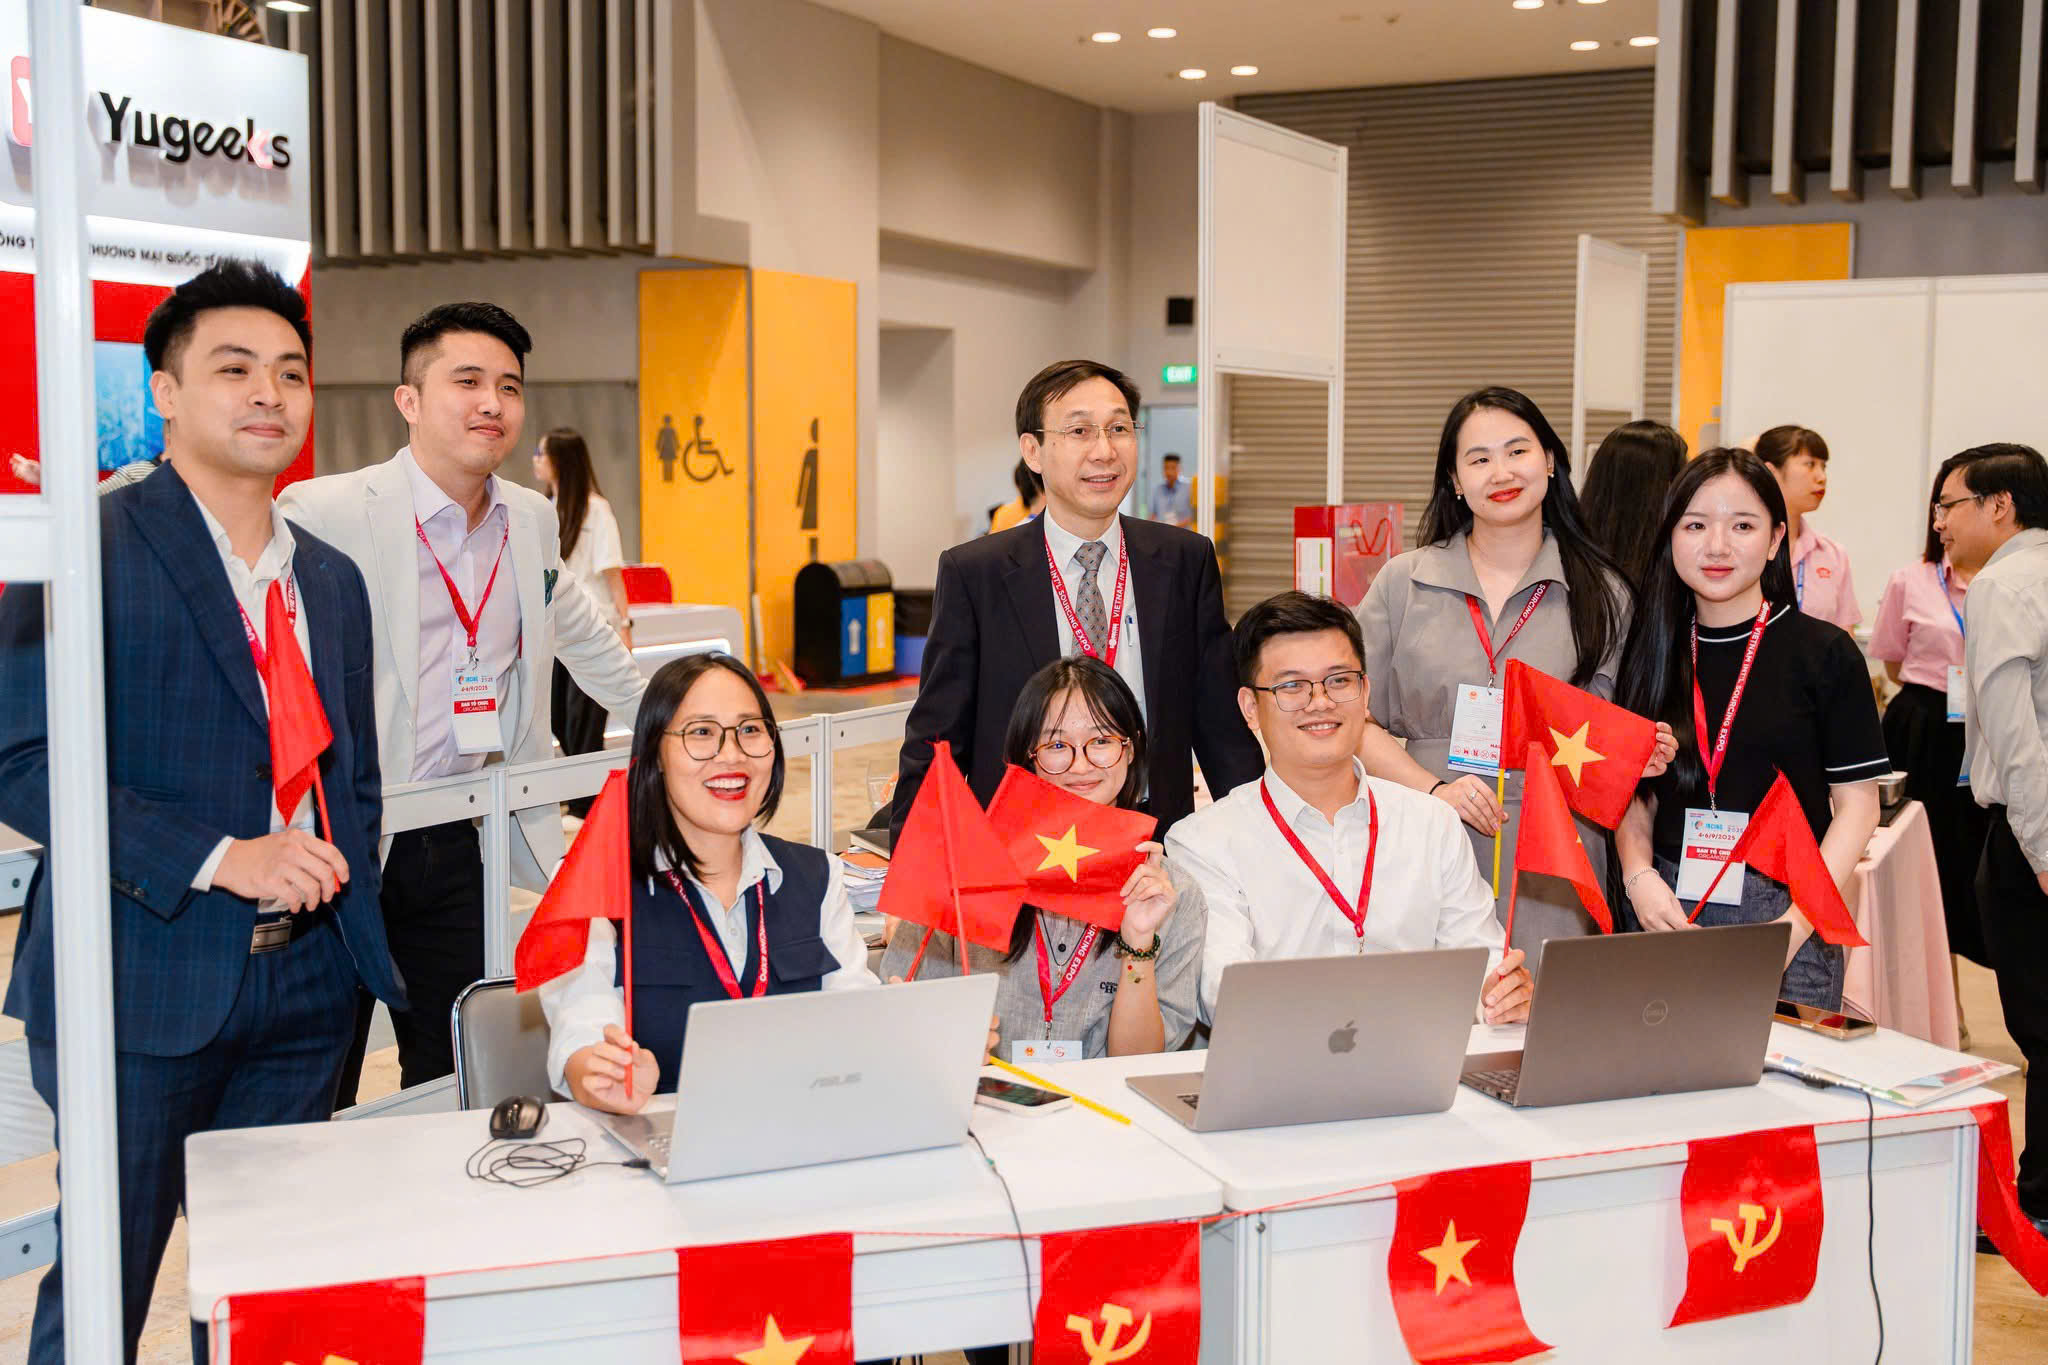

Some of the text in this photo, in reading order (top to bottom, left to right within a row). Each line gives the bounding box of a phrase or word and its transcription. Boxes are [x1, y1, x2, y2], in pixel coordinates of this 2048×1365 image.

[99, 91, 291, 169] Yugeeks
[1113, 585, 1125, 618] VIETNAM
[1523, 584, 1546, 618] SOURCING
[1058, 590, 1078, 629] SOURCING
[1075, 629, 1091, 651] EXPO
[1744, 627, 1762, 665] VIETNAM
[1723, 684, 1744, 727] SOURCING
[1716, 727, 1729, 752] EXPO
[1698, 832, 1736, 841] 4-6/9/2025
[1065, 958, 1081, 981] EXPO
